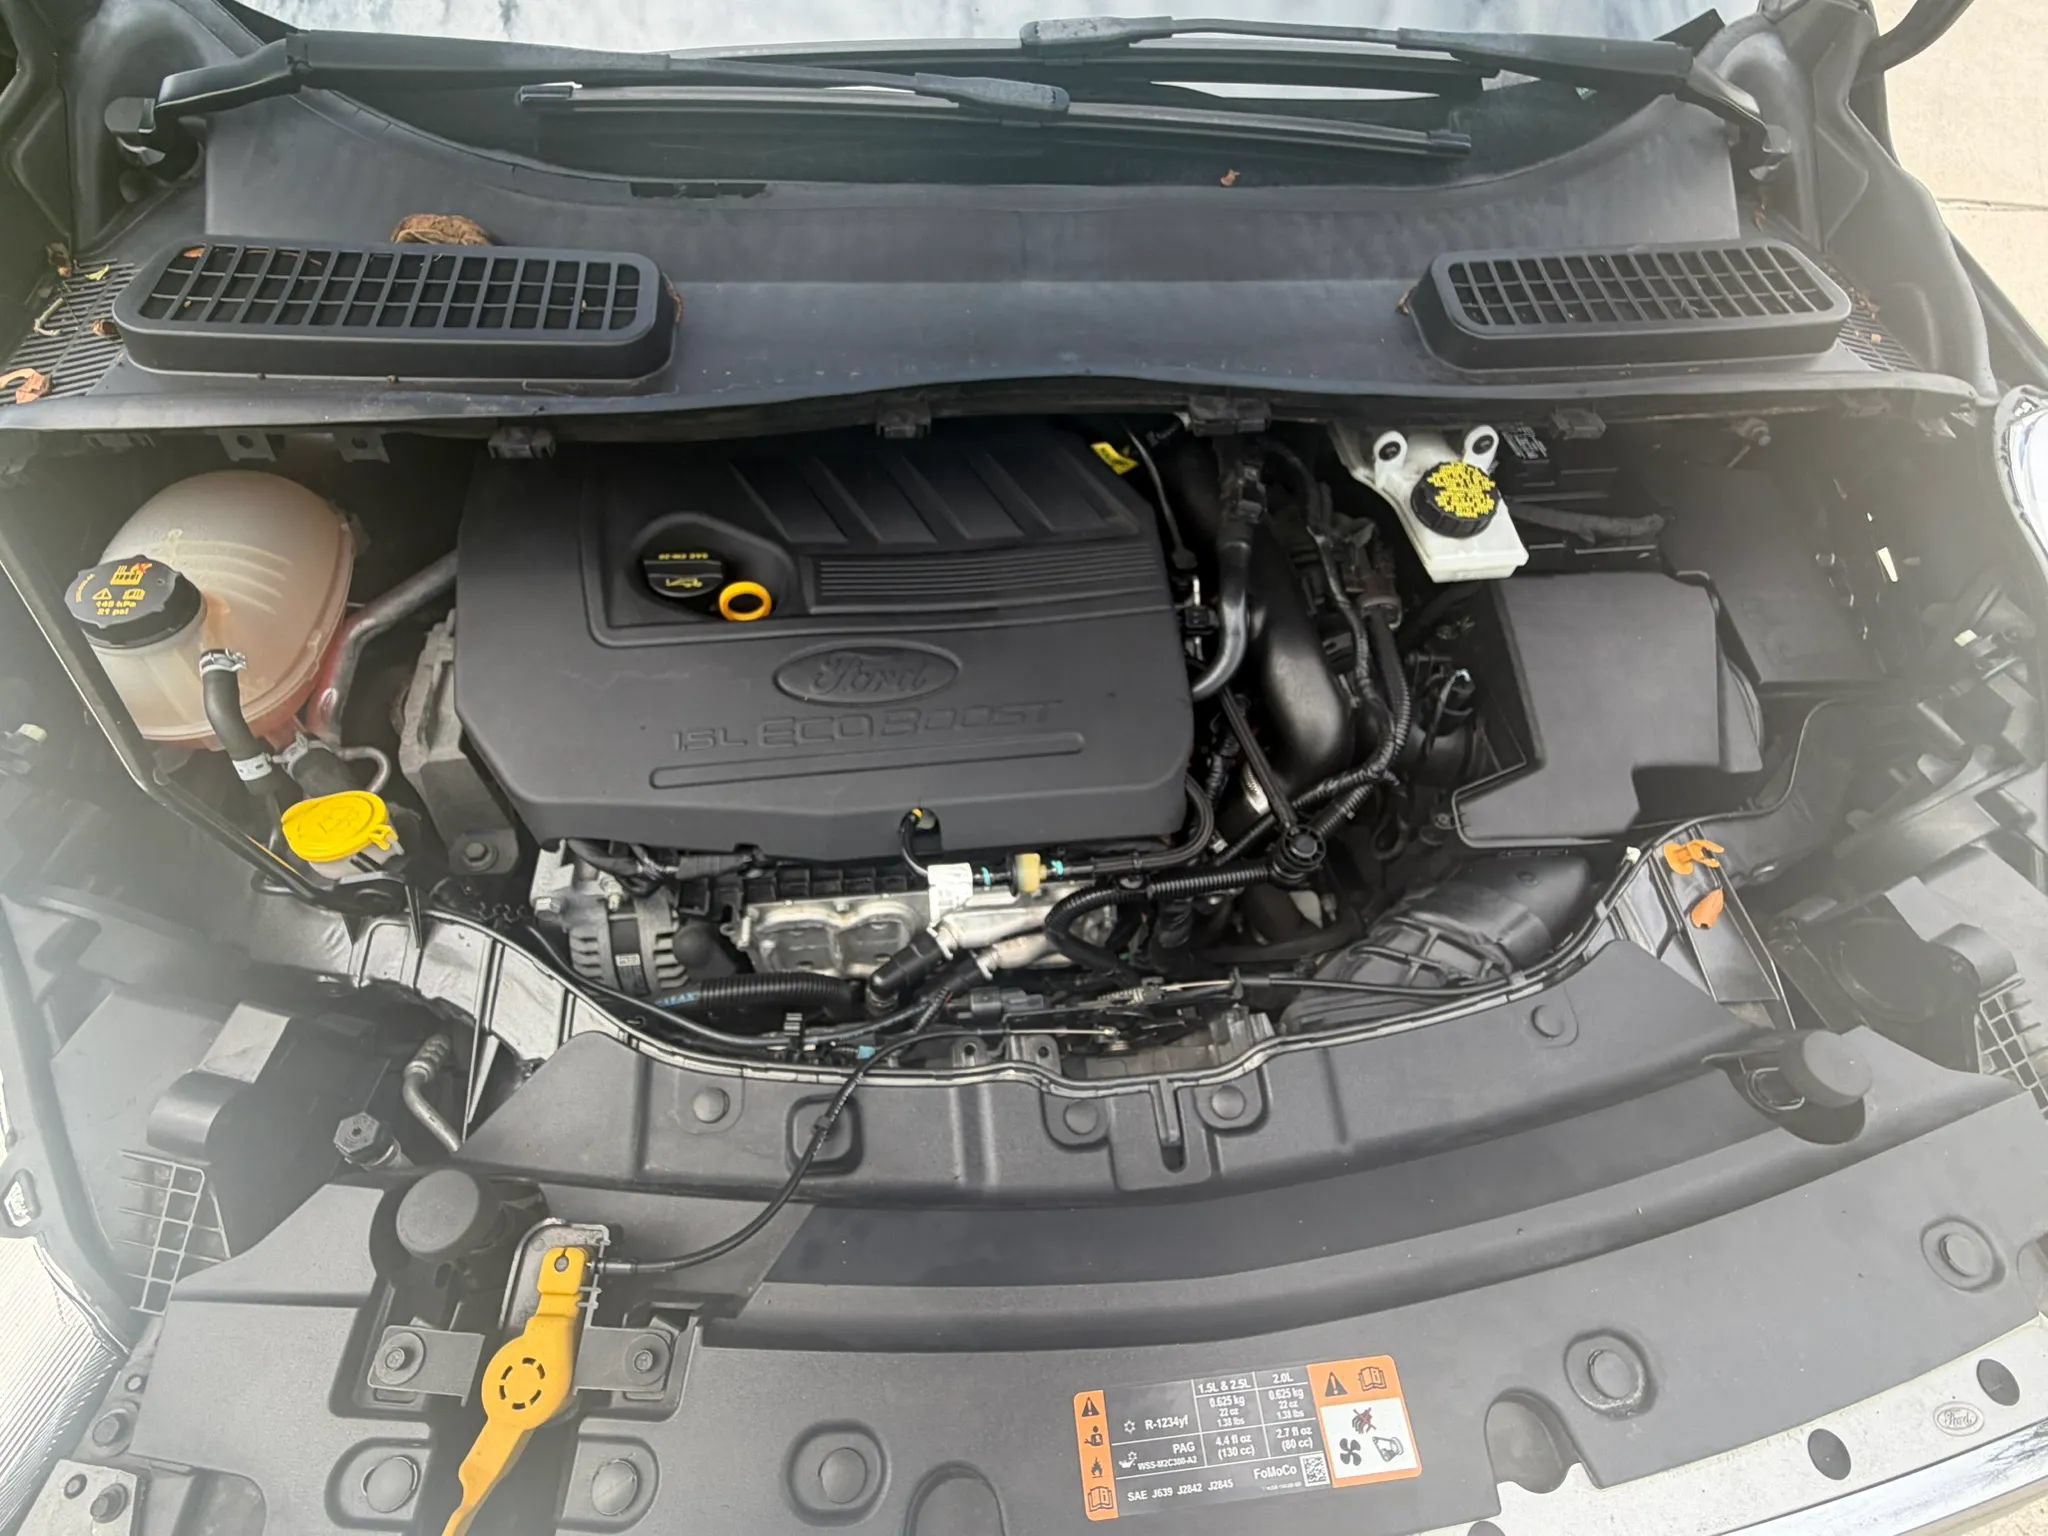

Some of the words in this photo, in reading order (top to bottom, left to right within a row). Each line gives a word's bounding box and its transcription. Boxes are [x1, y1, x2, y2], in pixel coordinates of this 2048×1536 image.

[807, 652, 934, 697] Ford
[757, 699, 1064, 749] ECOBOOST
[1271, 1372, 1294, 1384] 2.0L
[1198, 1382, 1219, 1394] 1.5L
[1220, 1380, 1229, 1391] &
[1229, 1378, 1252, 1389] 2.5L
[1292, 1387, 1304, 1399] kg
[1233, 1395, 1246, 1407] kg
[1144, 1414, 1189, 1431] R-1234yf
[1275, 1427, 1290, 1439] 2.7
[1291, 1426, 1299, 1437] fl
[1300, 1427, 1312, 1436] oz
[1172, 1441, 1196, 1455] PAG
[1215, 1435, 1230, 1447] 4.4
[1230, 1434, 1239, 1445] fl
[1240, 1434, 1252, 1443] oz
[1281, 1438, 1297, 1452] (80
[1298, 1437, 1313, 1449] cc)
[1217, 1446, 1239, 1460] (130
[1240, 1444, 1255, 1457] cc)
[1253, 1464, 1298, 1480] FoMoCo
[1127, 1489, 1148, 1502] SAE
[1151, 1487, 1174, 1499] J639
[1176, 1482, 1203, 1495] J2842
[1207, 1478, 1234, 1491] J2845
